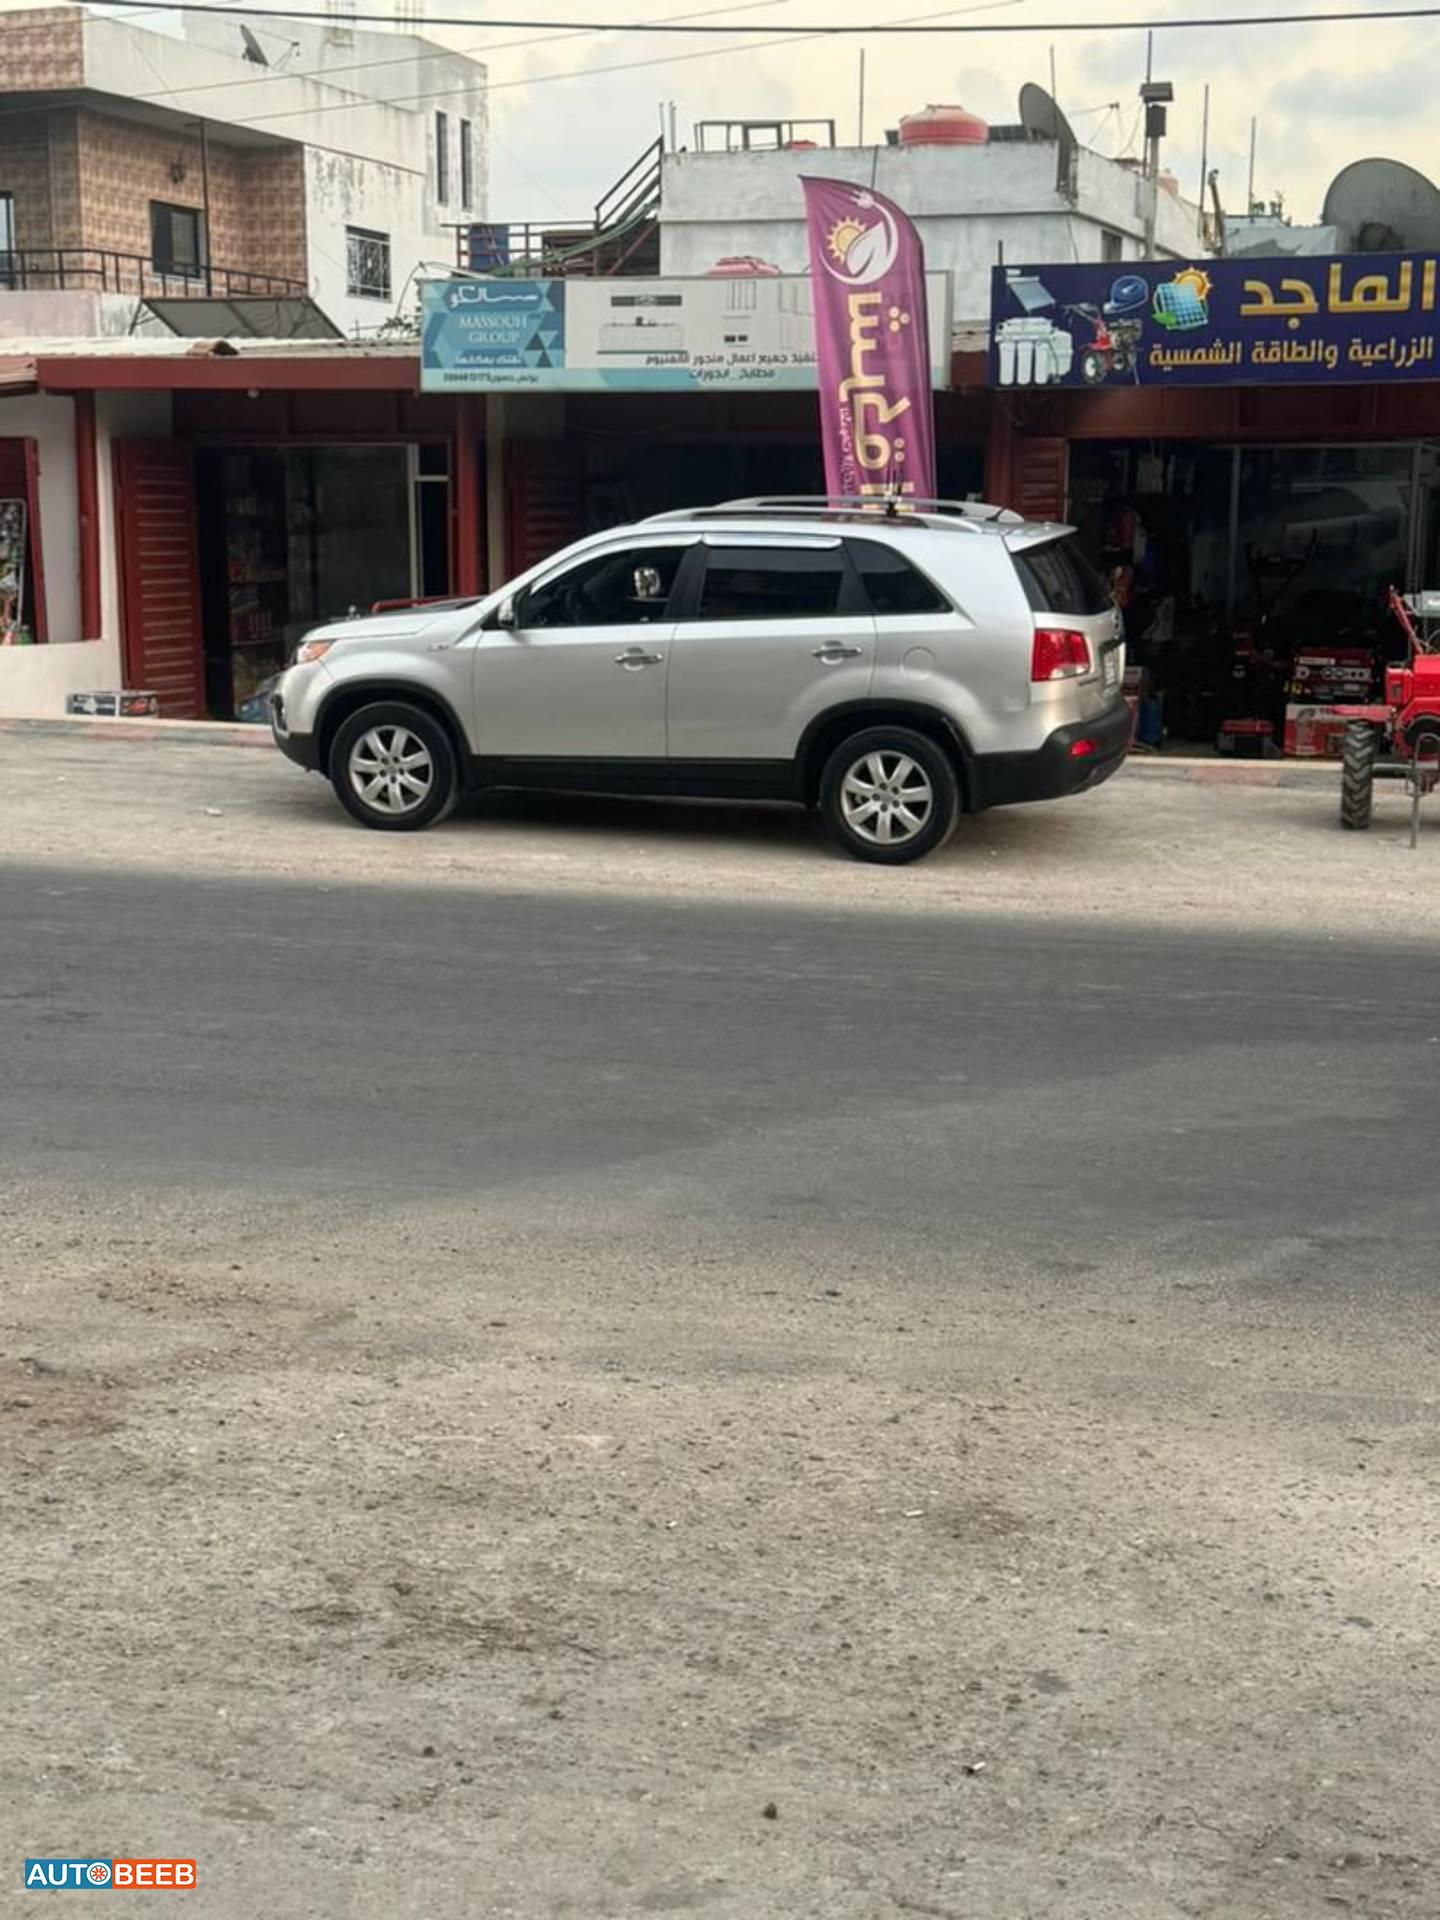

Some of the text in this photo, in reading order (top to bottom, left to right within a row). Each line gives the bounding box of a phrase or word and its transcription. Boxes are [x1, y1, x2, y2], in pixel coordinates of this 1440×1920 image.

[1240, 259, 1437, 330] الماجد
[458, 315, 528, 329] MASSOUH
[468, 331, 520, 343] GROUP
[758, 353, 789, 365] جميع
[1150, 336, 1435, 371] الزراعية والطاقة الشمسية
[738, 367, 777, 380] مطابخ
